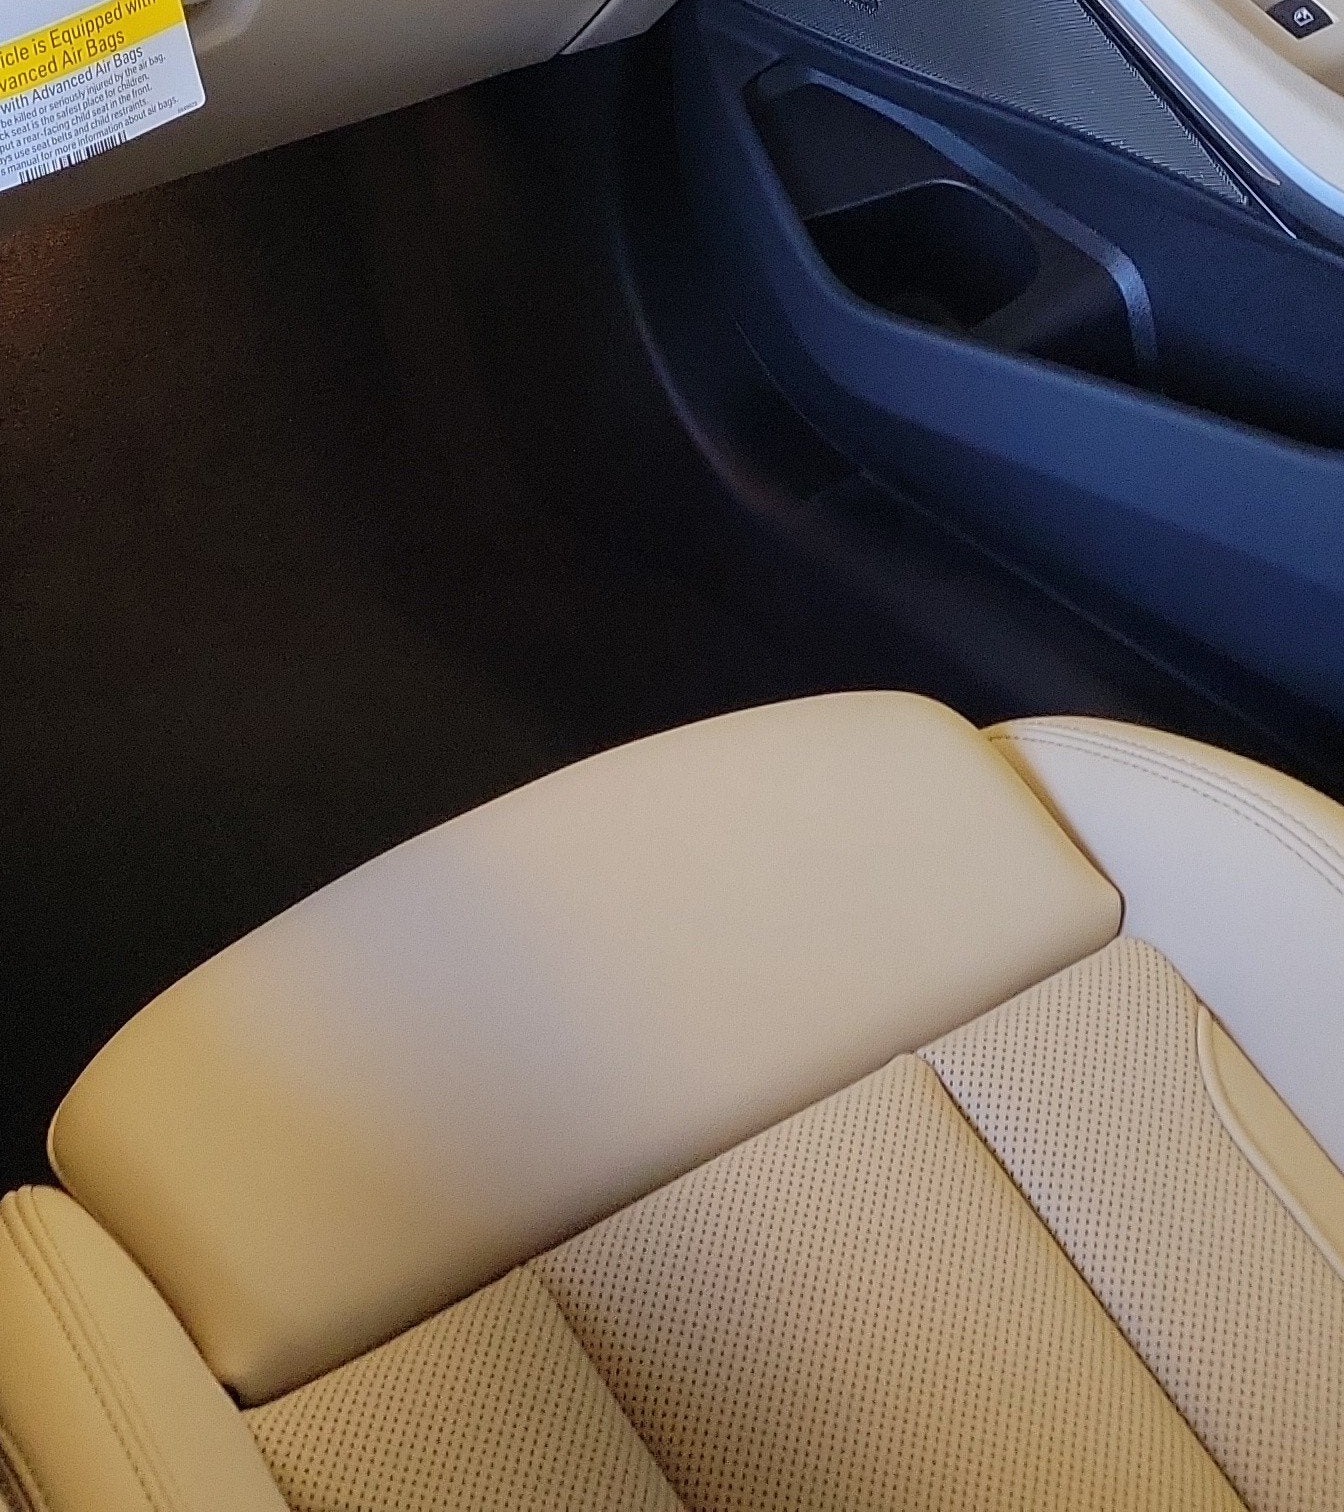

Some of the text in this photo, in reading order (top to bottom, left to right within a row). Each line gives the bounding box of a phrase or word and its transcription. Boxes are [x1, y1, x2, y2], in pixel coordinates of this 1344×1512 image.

[31, 38, 47, 56] is
[49, 1, 123, 49] Equipped
[62, 46, 83, 69] Air
[86, 29, 125, 57] Bags
[0, 94, 29, 115] with
[32, 66, 93, 104] Advanced
[95, 59, 111, 77] Air
[112, 47, 143, 68] Bags
[0, 118, 13, 128] be
[14, 110, 37, 124] killed
[39, 106, 47, 114] or
[49, 90, 86, 111] seriously
[115, 72, 124, 85] by
[125, 66, 136, 77] the
[0, 141, 15, 154] put
[23, 119, 70, 143] rear-facing
[71, 111, 91, 126] child
[92, 106, 109, 116] seat
[118, 94, 131, 105] the
[7, 156, 40, 173] manual
[55, 141, 76, 157] more
[77, 121, 124, 146] information
[125, 110, 148, 126] about
[11, 124, 30, 137] seat
[31, 119, 40, 128] is
[41, 116, 55, 127] the
[82, 94, 105, 112] place
[14, 148, 30, 159] use
[31, 139, 50, 152] seat
[51, 131, 72, 145] belts
